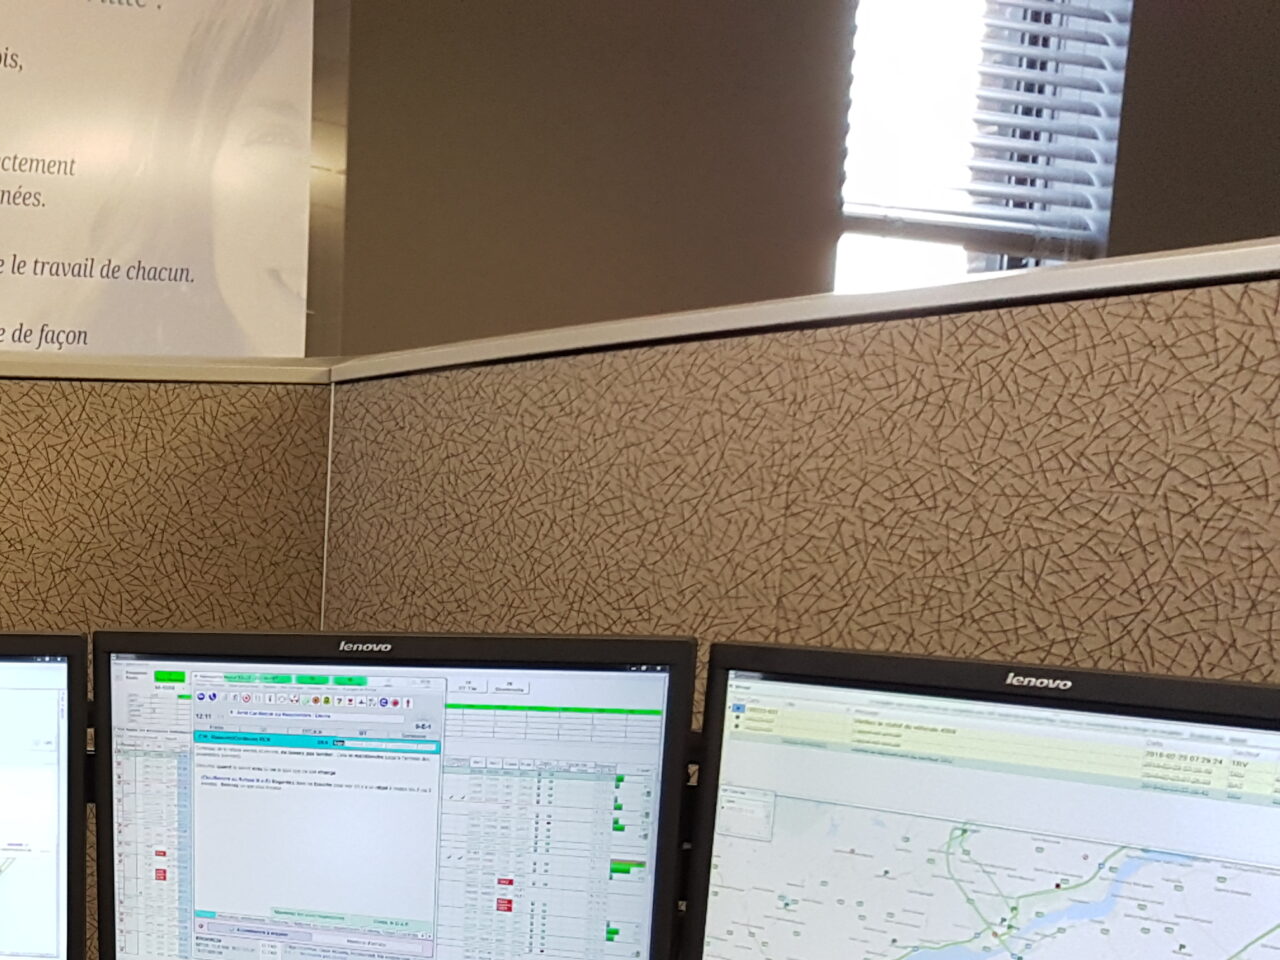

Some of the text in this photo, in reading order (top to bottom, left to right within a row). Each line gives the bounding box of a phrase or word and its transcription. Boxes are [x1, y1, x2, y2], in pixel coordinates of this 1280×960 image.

[10, 252, 28, 276] le
[32, 256, 96, 279] travail
[99, 257, 122, 280] de
[125, 259, 195, 284] chacun.
[10, 321, 33, 345] de
[36, 322, 89, 351] façon
[338, 640, 392, 652] lenovo
[1005, 672, 1072, 690] lenovo
